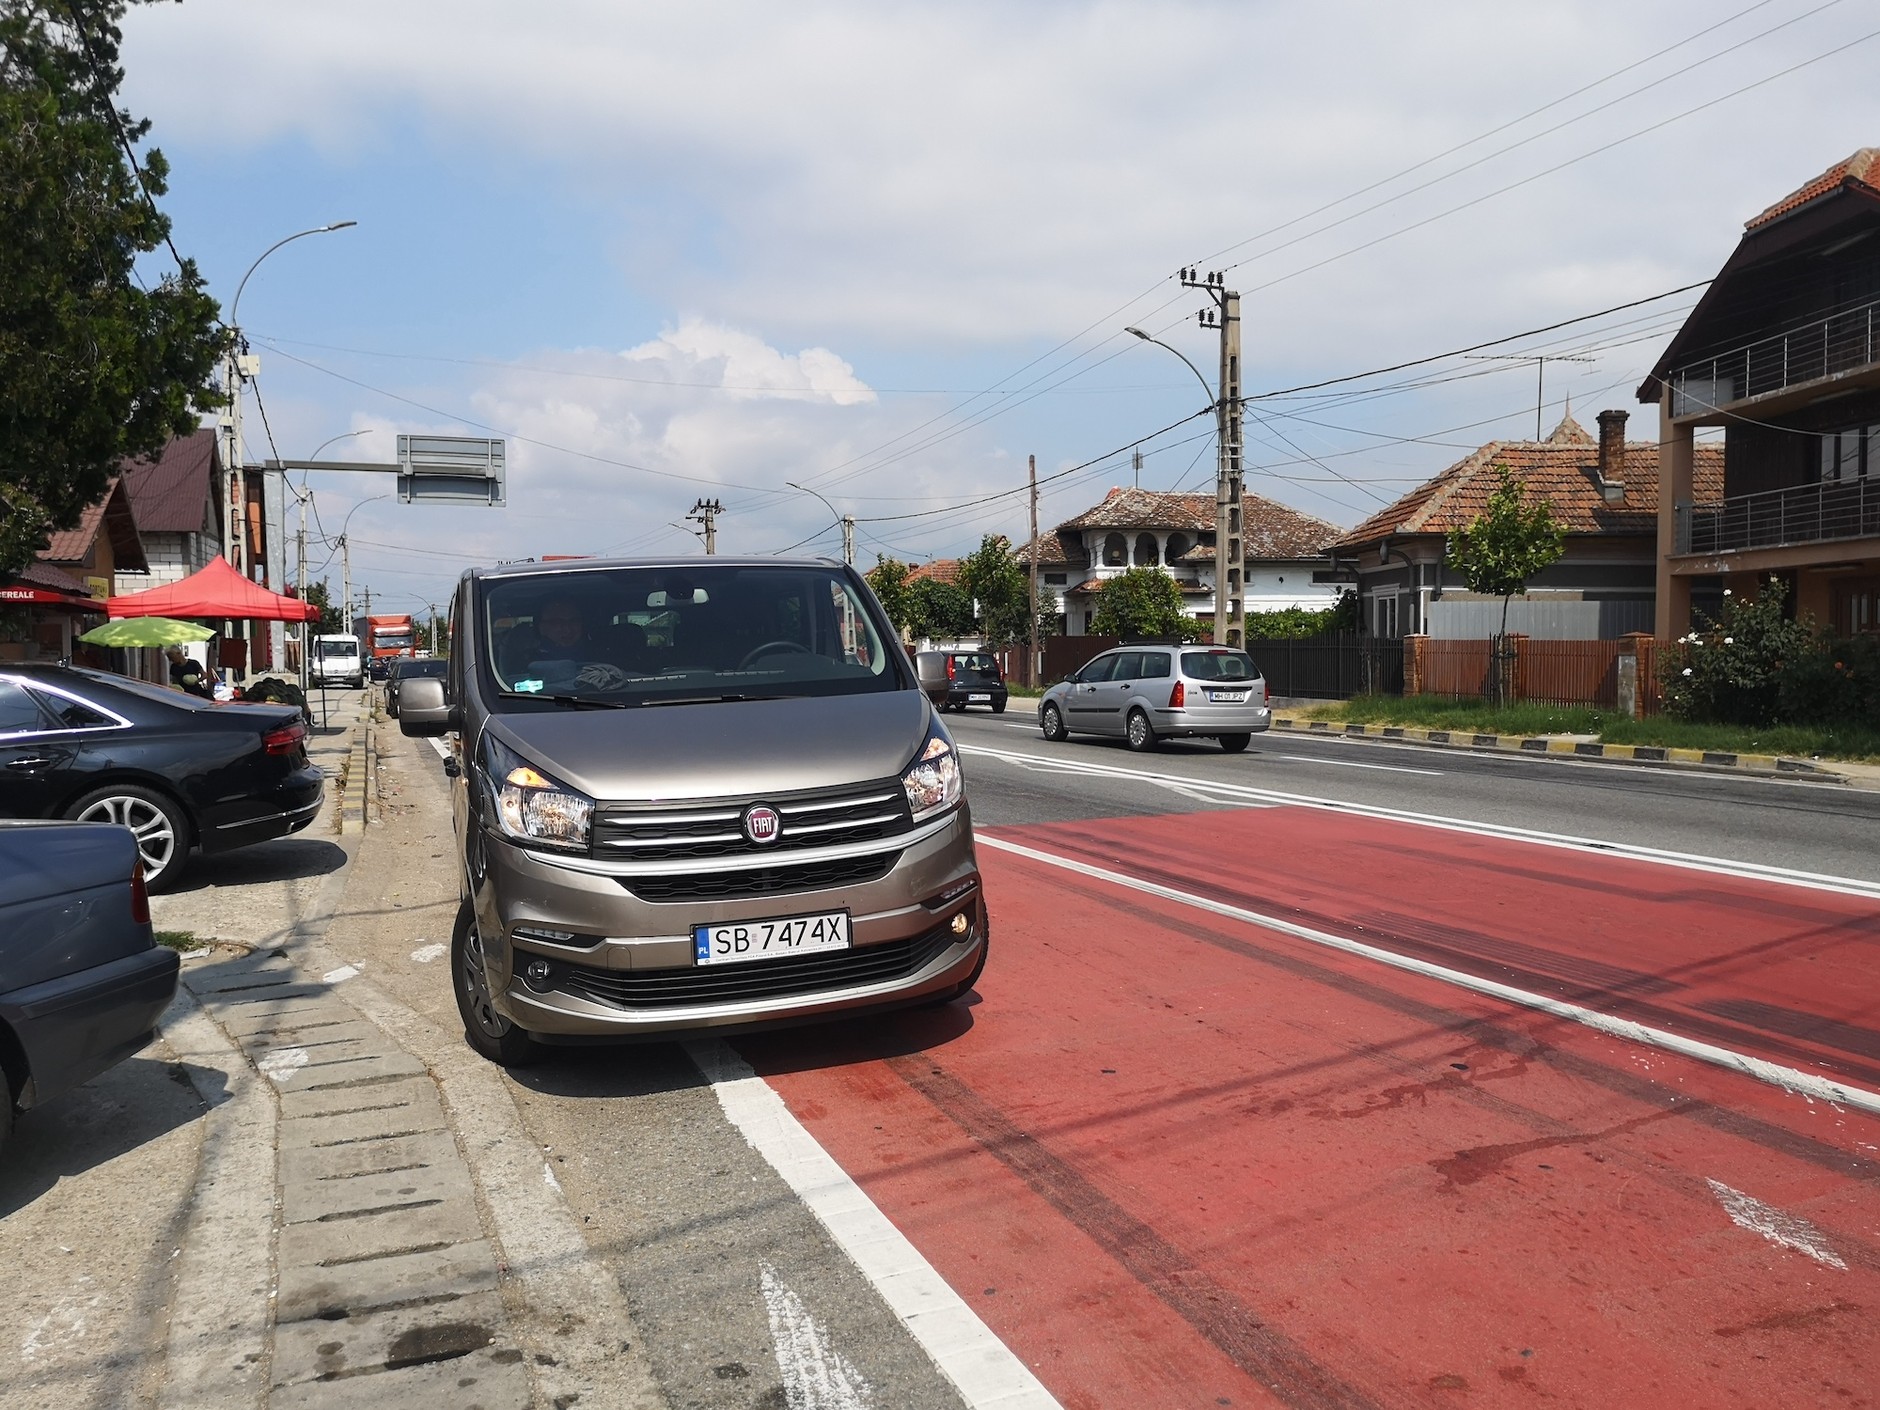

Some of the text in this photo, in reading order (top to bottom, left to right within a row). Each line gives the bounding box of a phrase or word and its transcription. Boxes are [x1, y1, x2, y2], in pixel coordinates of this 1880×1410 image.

[753, 817, 773, 833] FIAT
[715, 928, 750, 954] SB
[761, 917, 841, 950] 7474X
[698, 946, 708, 954] PL
